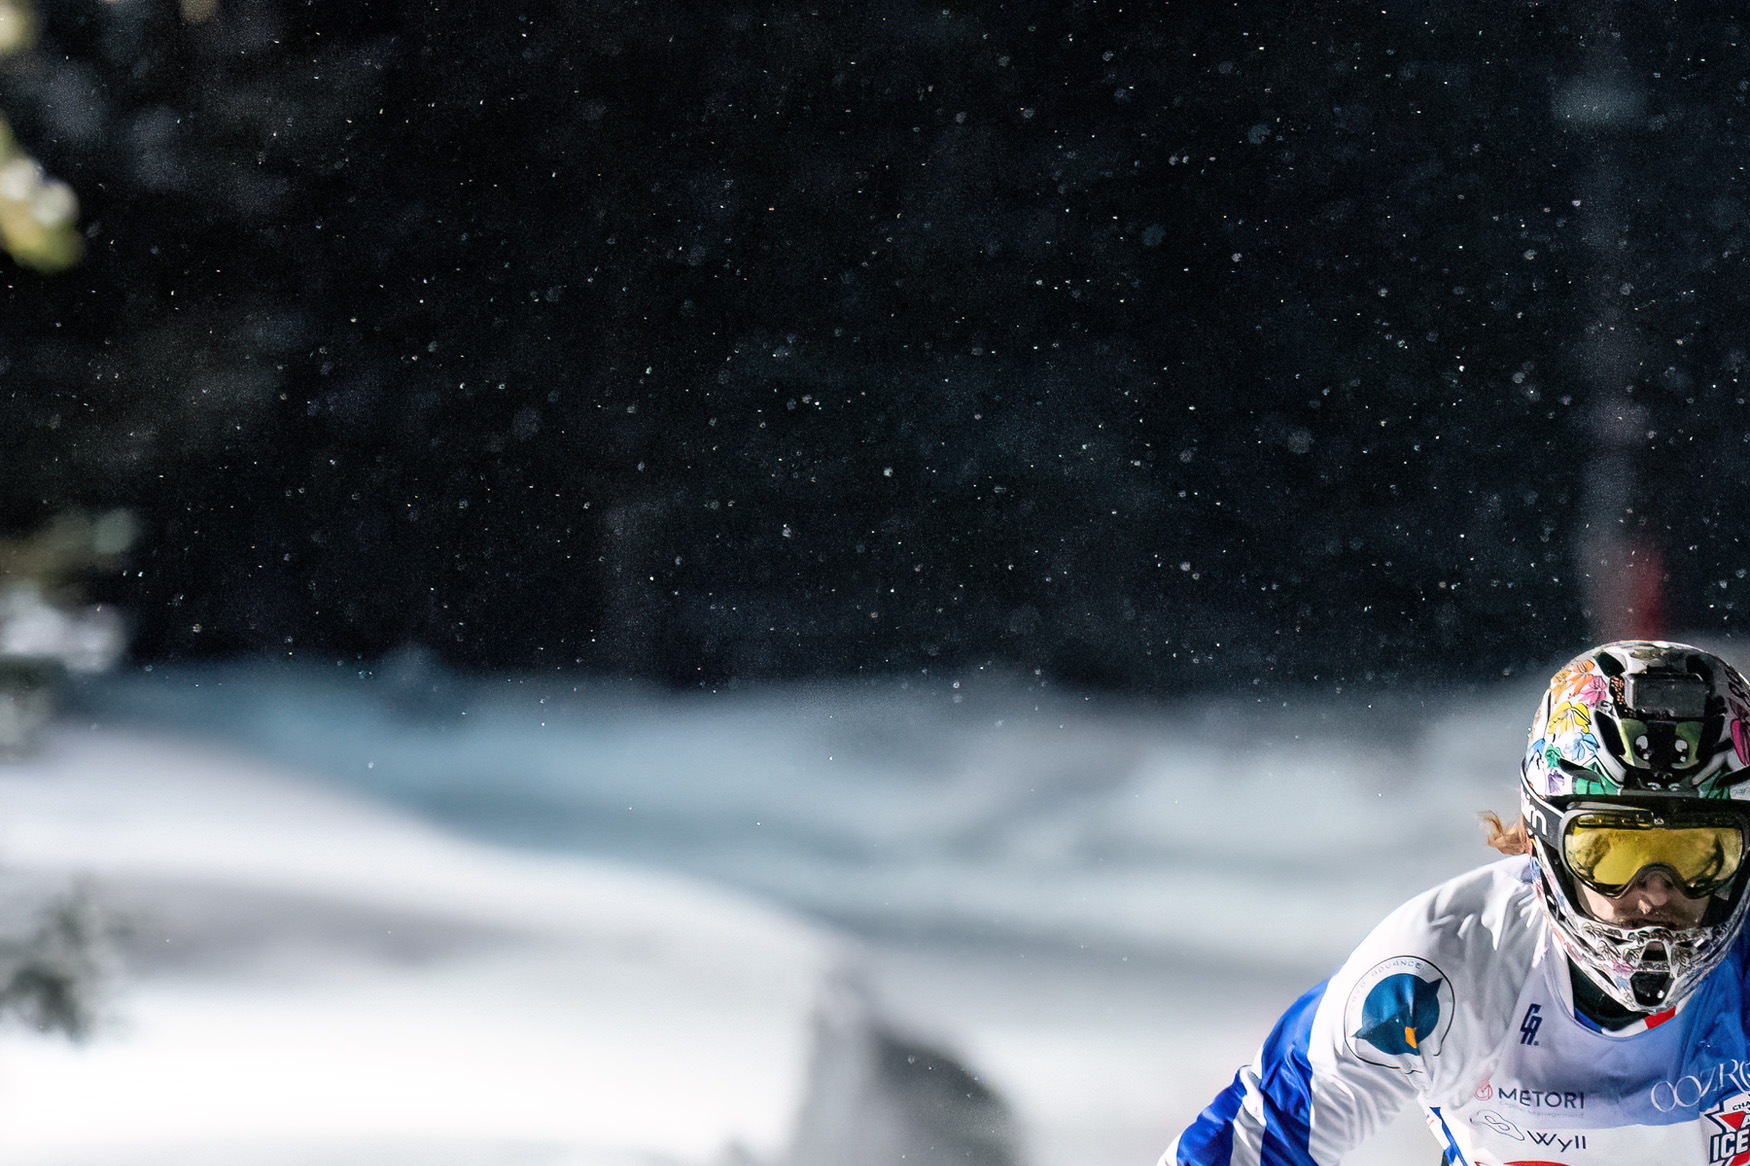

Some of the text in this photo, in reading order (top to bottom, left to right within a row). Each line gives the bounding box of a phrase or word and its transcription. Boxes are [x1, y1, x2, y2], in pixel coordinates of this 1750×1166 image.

[1498, 1087, 1585, 1109] METORI
[1527, 1130, 1587, 1152] Wyll
[1713, 1128, 1750, 1161] ICE
